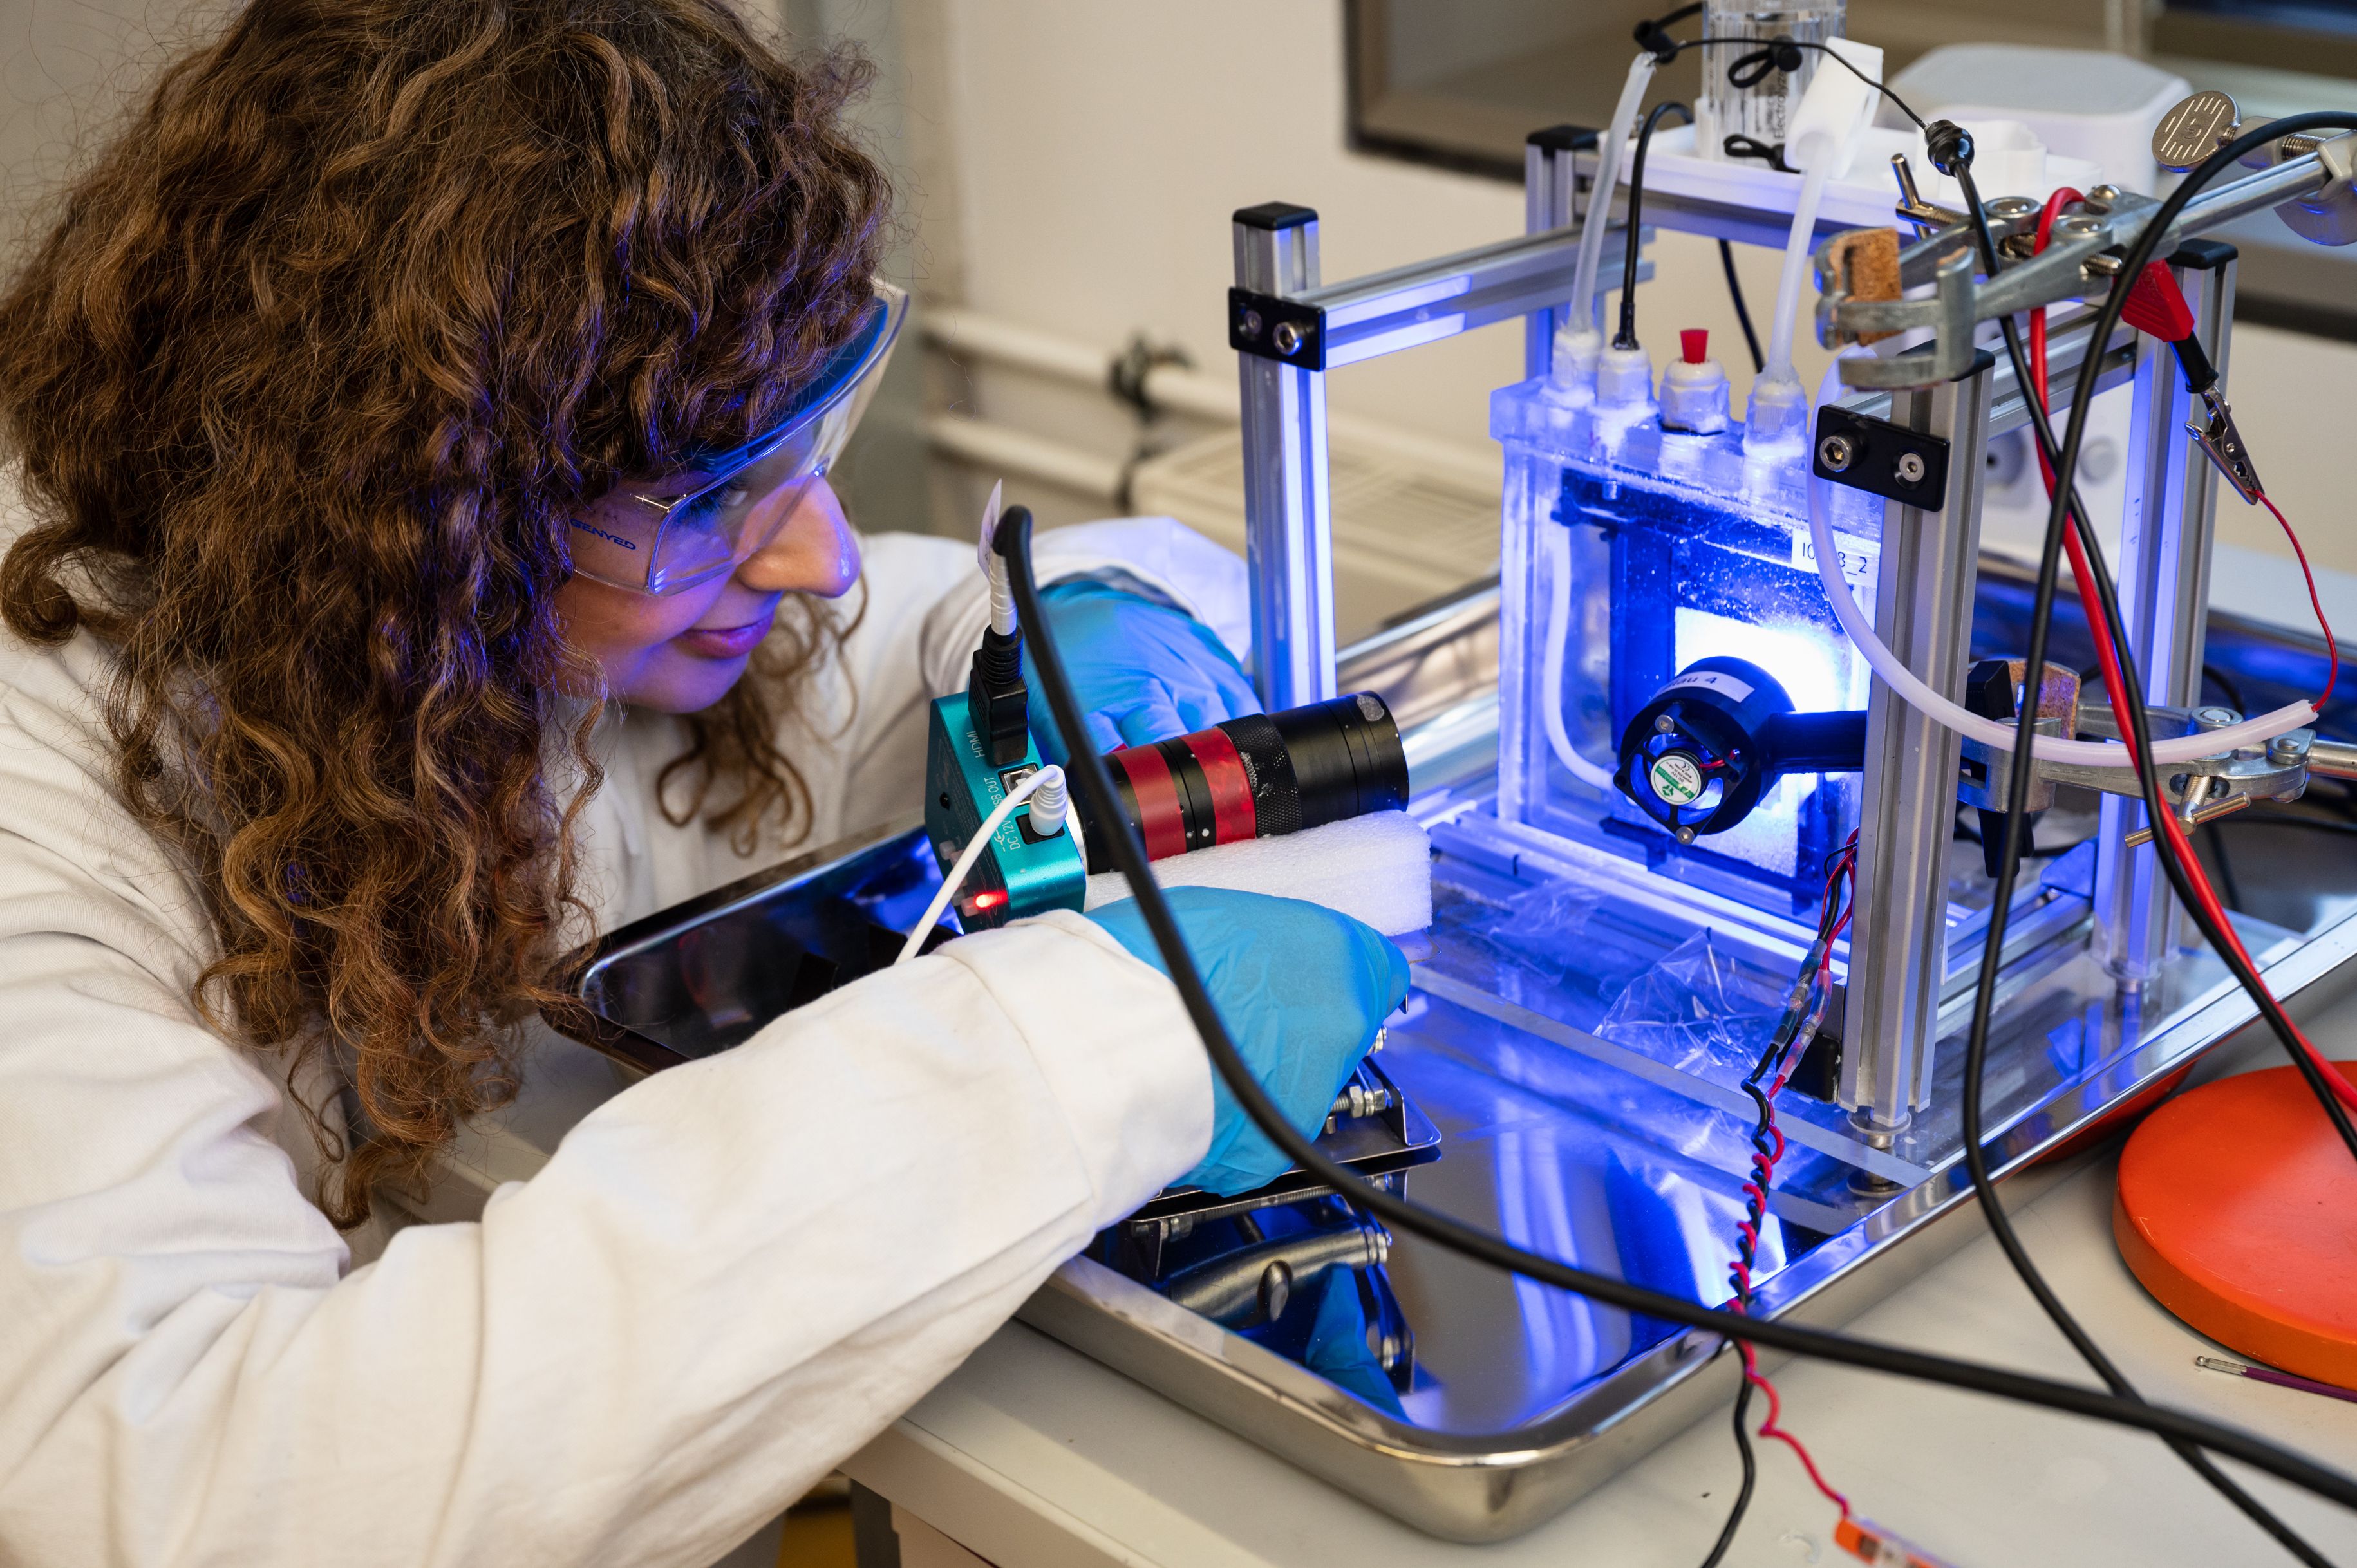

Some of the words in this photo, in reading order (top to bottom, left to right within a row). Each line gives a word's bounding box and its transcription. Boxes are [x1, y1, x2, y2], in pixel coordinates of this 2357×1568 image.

[966, 731, 985, 758] HDMI
[983, 777, 999, 793] OUT
[991, 792, 1004, 809] SB
[1001, 819, 1015, 835] 12V
[1007, 836, 1021, 850] DC
